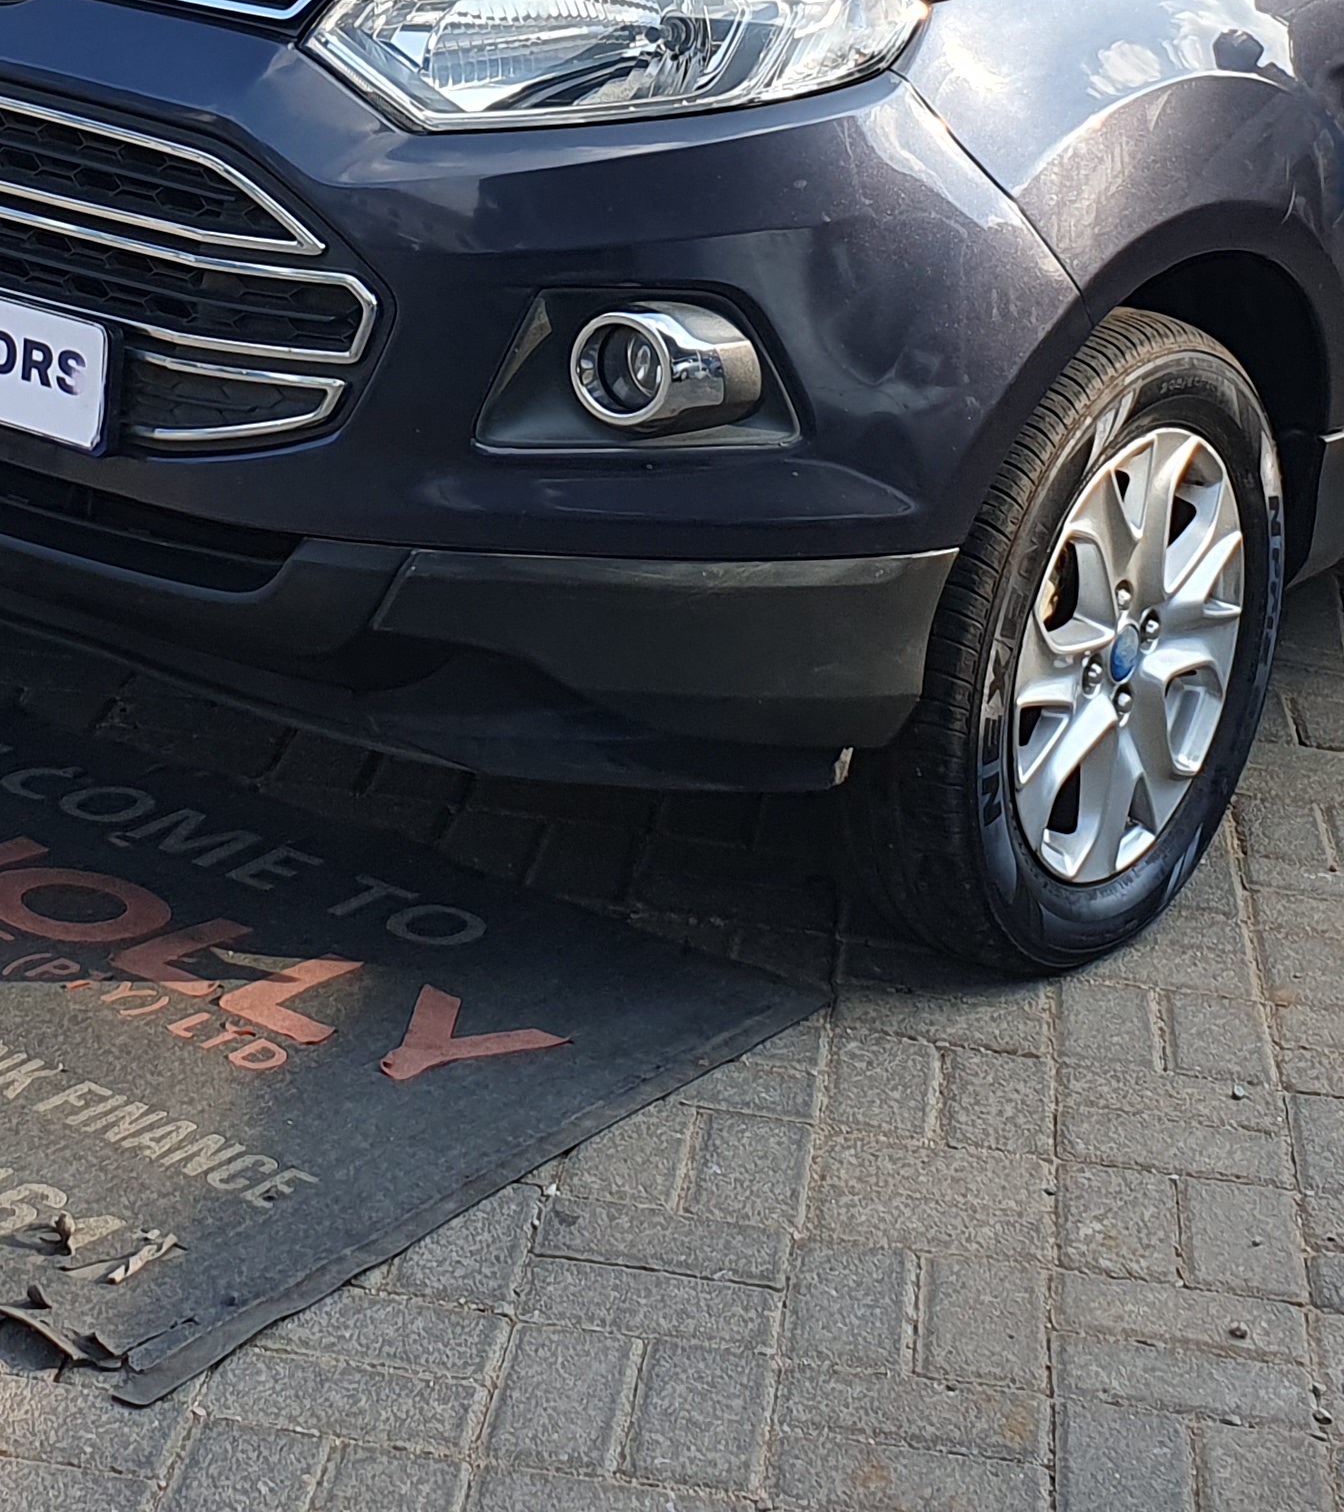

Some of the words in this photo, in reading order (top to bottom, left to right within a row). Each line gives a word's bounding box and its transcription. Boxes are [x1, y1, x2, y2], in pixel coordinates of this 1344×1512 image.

[327, 874, 488, 947] TO
[167, 1012, 288, 1070] LTD
[32, 1080, 321, 1210] FINANCE
